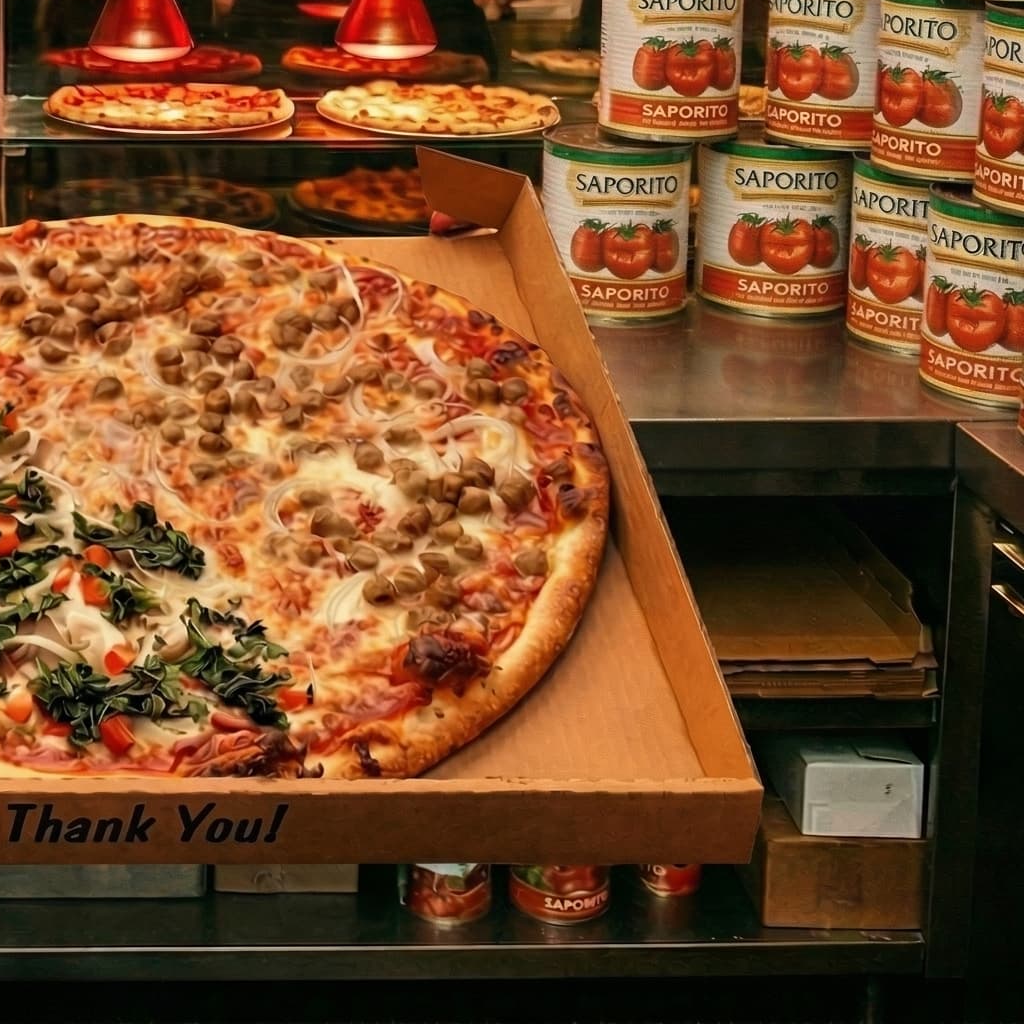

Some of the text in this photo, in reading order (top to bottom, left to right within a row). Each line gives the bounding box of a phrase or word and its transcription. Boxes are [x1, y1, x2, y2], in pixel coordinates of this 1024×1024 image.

[642, 103, 729, 120] SAPORITO
[575, 174, 679, 195] SAPORITO
[735, 168, 839, 190] SAPORITO
[930, 224, 1024, 262] SAPORIT
[581, 284, 670, 301] SAPORITO
[738, 278, 829, 296] SAPORITO
[7, 802, 289, 843] Thank You!
